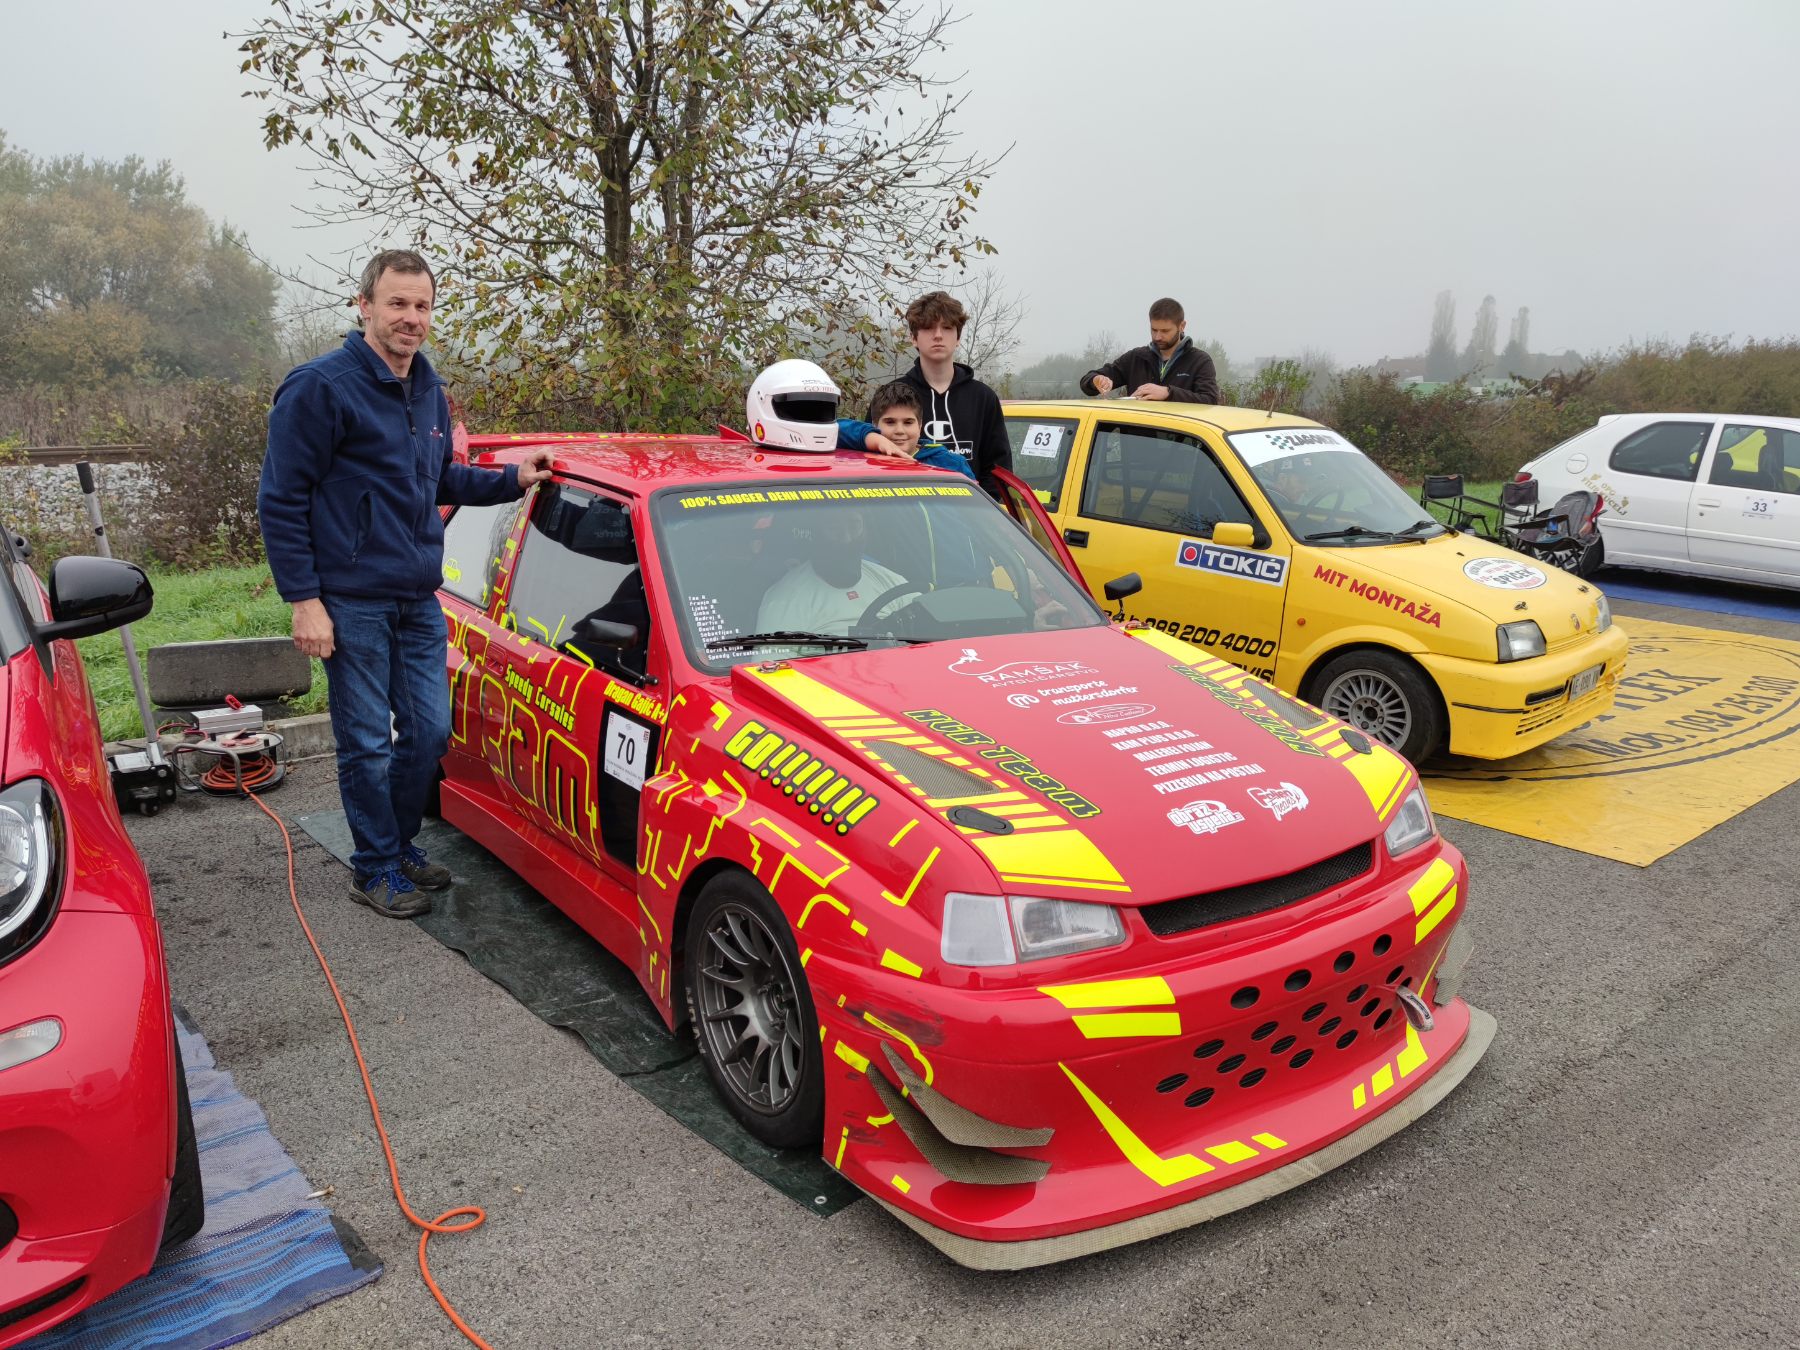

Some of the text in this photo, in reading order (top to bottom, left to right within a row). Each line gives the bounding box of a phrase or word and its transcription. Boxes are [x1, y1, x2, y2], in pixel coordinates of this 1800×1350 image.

[1034, 432, 1051, 446] 63
[680, 496, 717, 509] 100%
[716, 492, 769, 505] SAUGER,
[767, 490, 800, 502] DENN
[798, 489, 824, 500] NUR
[822, 489, 852, 499] TOTE
[850, 487, 895, 499] MÜSSEN
[934, 486, 973, 497] WERDEN
[1752, 501, 1767, 512] 33
[1204, 549, 1281, 579] TOKIĆ
[1313, 564, 1441, 629] MIT MONTAŽA
[1179, 624, 1221, 646] 200
[1219, 633, 1277, 658] 4000
[977, 662, 1090, 683] RAMŠAK
[505, 663, 575, 733] Speedy Corsales
[603, 680, 665, 721] Dragan Gajić A+
[1037, 680, 1108, 696] transporte
[617, 731, 635, 765] 70
[1111, 739, 1143, 751] KAM
[1139, 734, 1170, 746] PLUS
[1566, 731, 1699, 758] Mob.
[1144, 751, 1238, 777] TERMIN LOGISTIC
[978, 745, 1103, 819] Team
[1152, 774, 1211, 795] PIZZERIJA
[1204, 769, 1226, 783] NA
[1168, 803, 1214, 827] obraz
